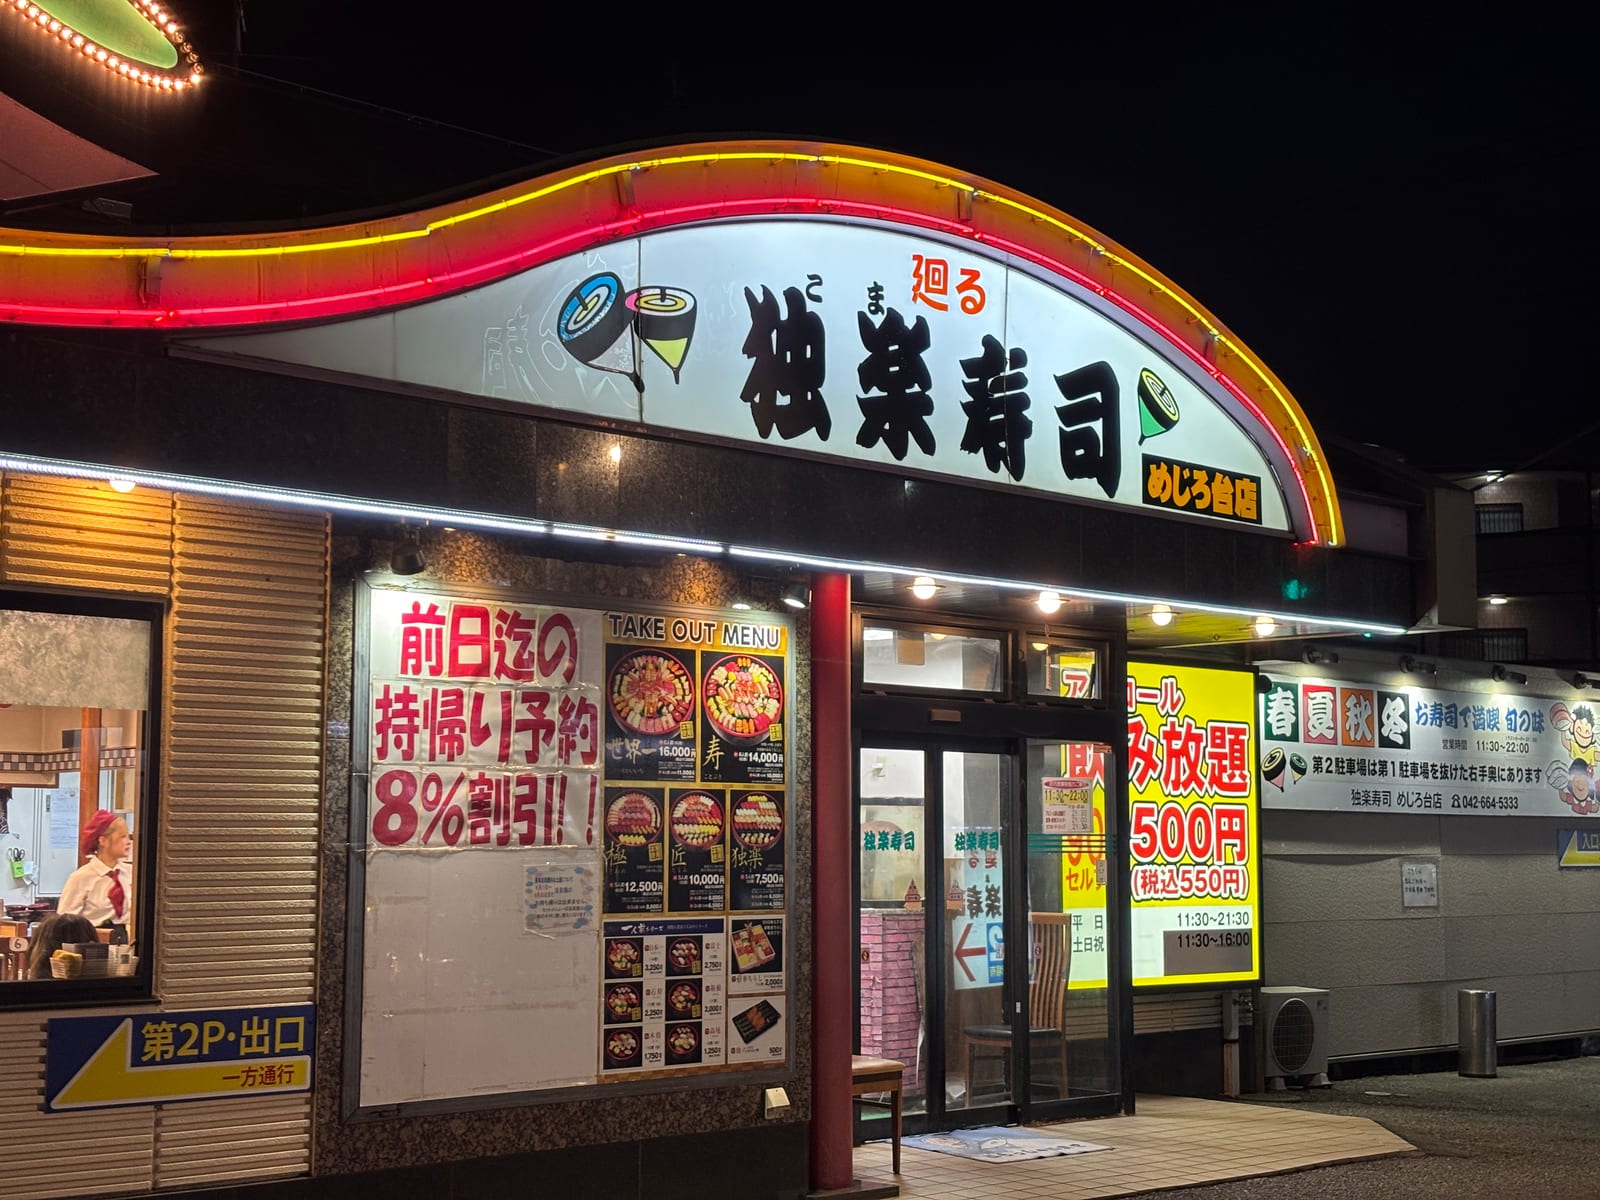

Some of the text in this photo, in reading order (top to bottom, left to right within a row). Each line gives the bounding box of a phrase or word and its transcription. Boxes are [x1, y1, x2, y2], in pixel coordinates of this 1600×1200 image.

[911, 254, 987, 315] 廻る
[739, 284, 1122, 499] 独楽寿司
[1147, 461, 1257, 520] めじろ台店
[400, 601, 578, 684] 前日迄の
[608, 614, 780, 649] TAKE OUT MENU
[375, 685, 598, 765] 持帰り予約
[1266, 686, 1408, 745] 春夏秋冬
[1415, 701, 1545, 735] お寿司で満喫 旬の味
[703, 735, 725, 770] 寿
[1351, 788, 1519, 810] 独楽寿司 めじろ台店 042-664-5333
[863, 830, 915, 852] 独楽寿司
[954, 831, 999, 852] 独楽寿司
[1131, 806, 1247, 863] 500円
[731, 845, 764, 870] 独楽
[1133, 866, 1248, 896] (税込550円)
[1177, 911, 1250, 927] 11:30~21:30
[1073, 932, 1250, 953] 土日祝 11:30~16:00
[222, 1064, 295, 1088] 一方通行
